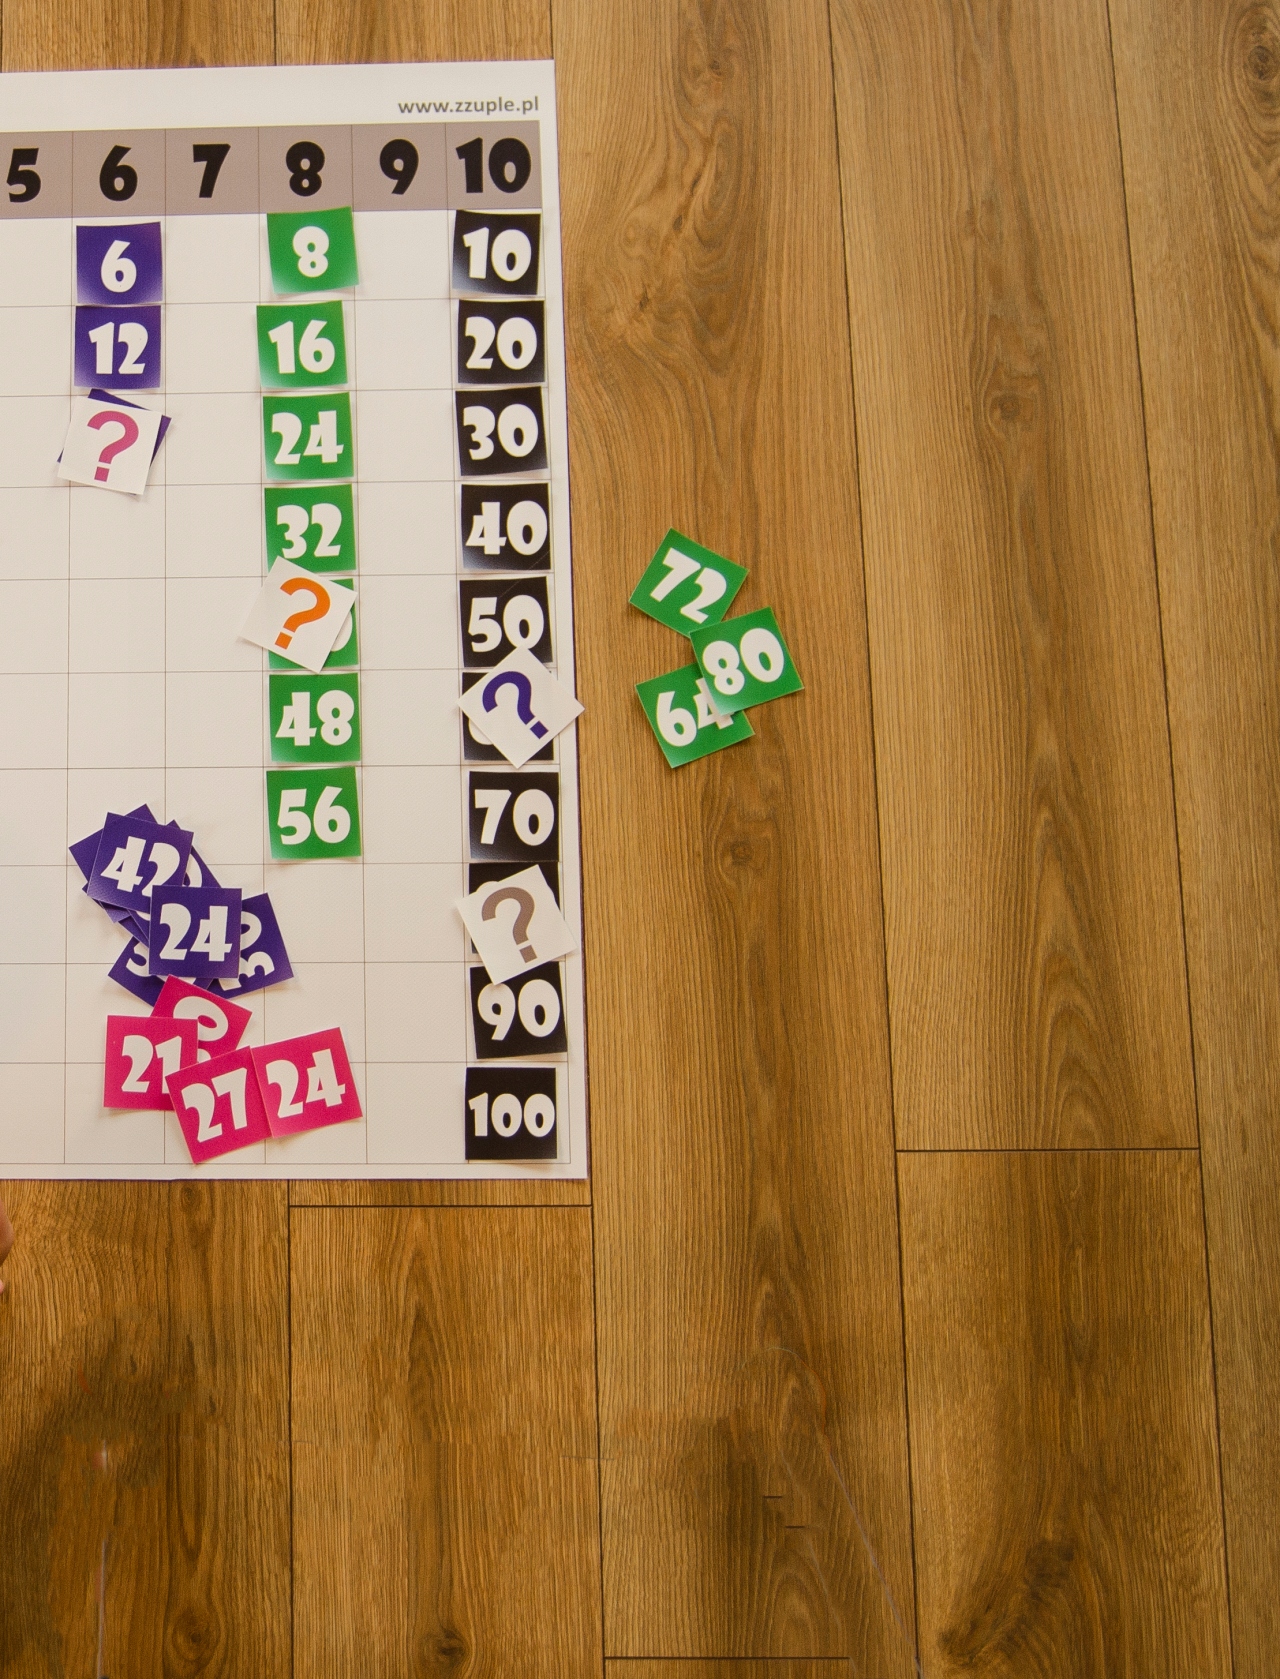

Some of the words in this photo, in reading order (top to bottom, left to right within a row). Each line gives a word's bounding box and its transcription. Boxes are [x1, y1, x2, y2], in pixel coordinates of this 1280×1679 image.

[398, 95, 539, 116] www.zzuple.pl
[6, 147, 42, 203] 5
[99, 145, 138, 201] 6
[193, 143, 231, 198] 7
[285, 141, 325, 197] 8
[380, 138, 419, 195] 9
[456, 137, 532, 193] 10
[100, 239, 137, 293] 6
[292, 226, 330, 278] 8
[462, 227, 533, 282] 10
[88, 321, 149, 375] 12
[267, 319, 335, 374] 16
[464, 316, 538, 371] 20
[271, 410, 344, 466] 24
[463, 404, 539, 461] 30
[275, 502, 342, 560] 32
[465, 500, 548, 556] 40
[649, 547, 727, 624] 72
[466, 595, 545, 653] 50
[702, 627, 784, 697] 80
[275, 689, 355, 747] 48
[656, 677, 734, 747] 64
[277, 785, 351, 846] 56
[474, 788, 555, 846] 70
[100, 835, 180, 898] 42
[158, 902, 233, 962] 24
[477, 979, 561, 1041] 90
[121, 1034, 183, 1094] 21
[265, 1048, 346, 1119] 24
[181, 1067, 248, 1143] 27
[468, 1091, 555, 1137] 100
